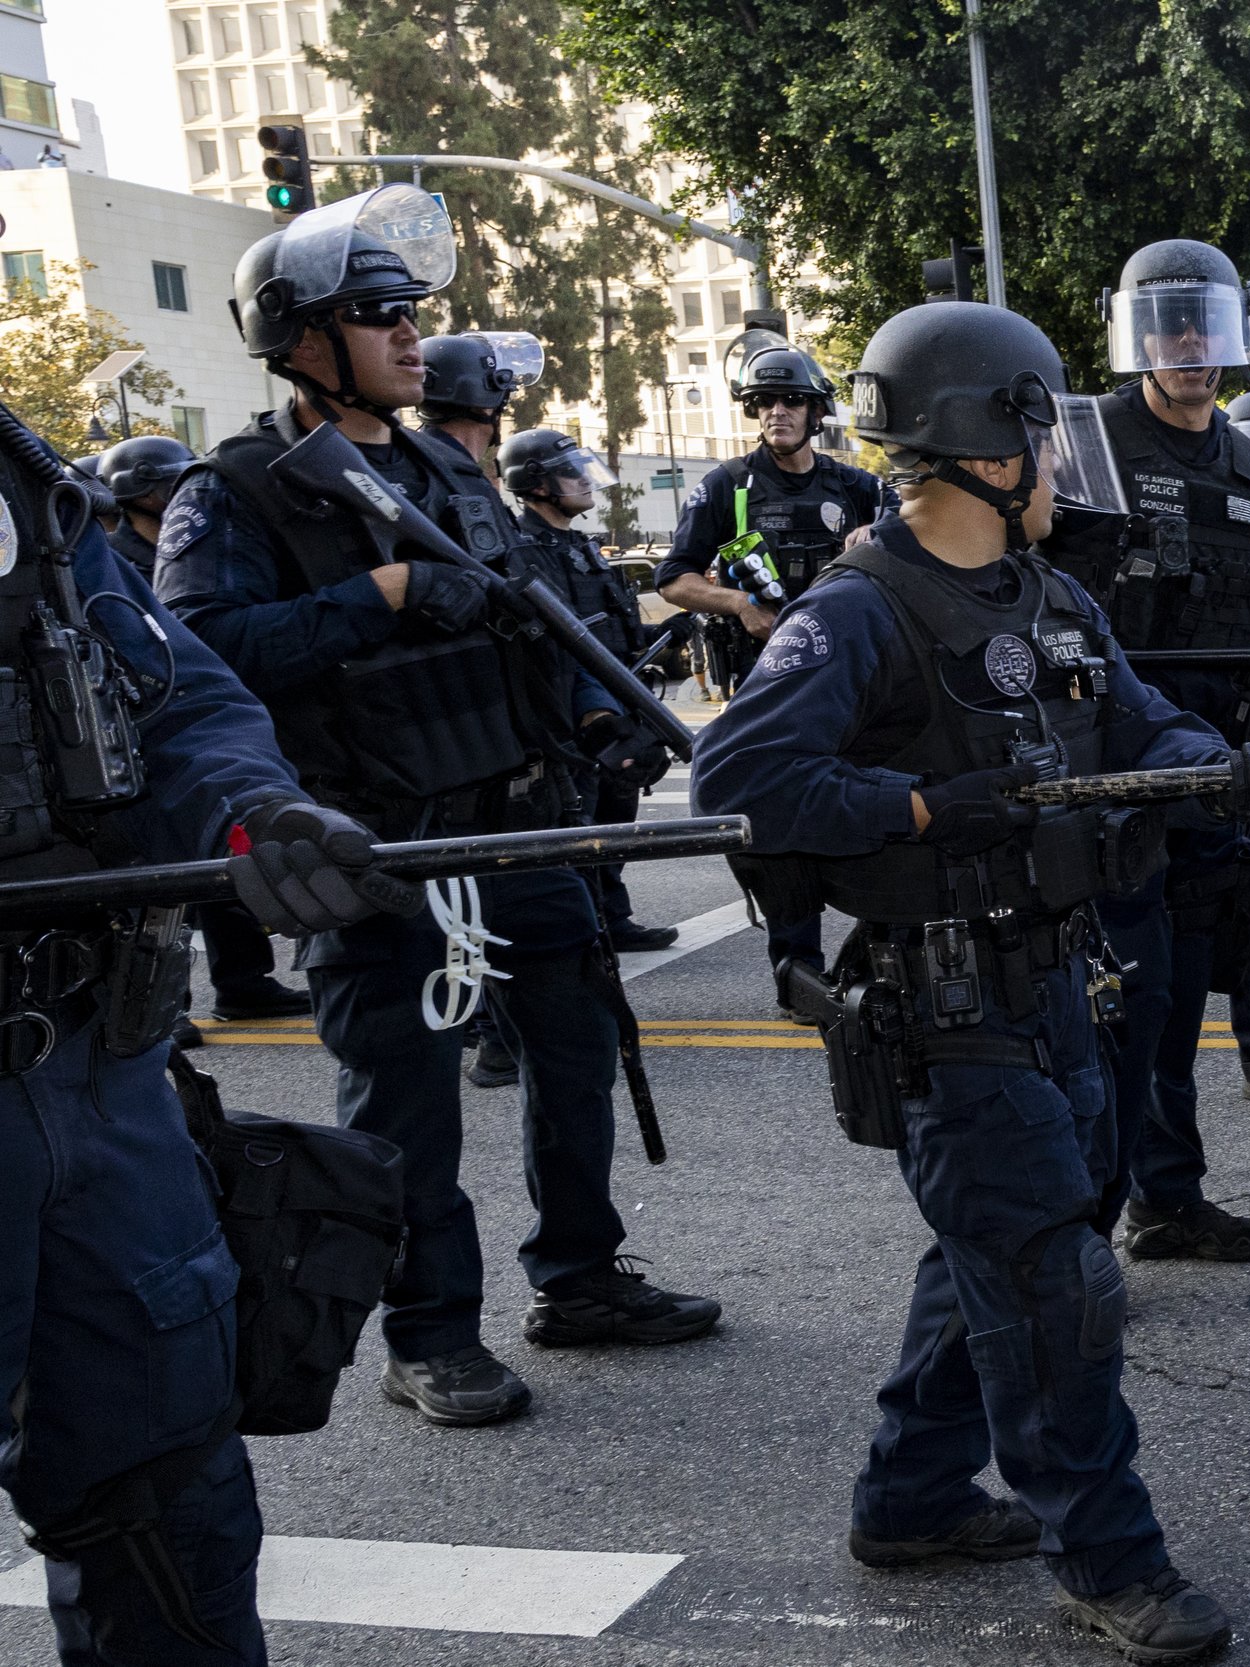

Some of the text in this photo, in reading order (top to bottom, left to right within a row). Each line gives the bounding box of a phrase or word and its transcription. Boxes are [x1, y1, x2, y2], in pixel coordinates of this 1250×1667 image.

[1134, 473, 1185, 488] LOS ANGELES
[1142, 483, 1180, 497] POLICE
[1139, 499, 1185, 515] GONZALEZ
[760, 521, 788, 529] POLICE
[1041, 630, 1084, 647] LOS ANGELES
[1052, 643, 1084, 661] POLICE
